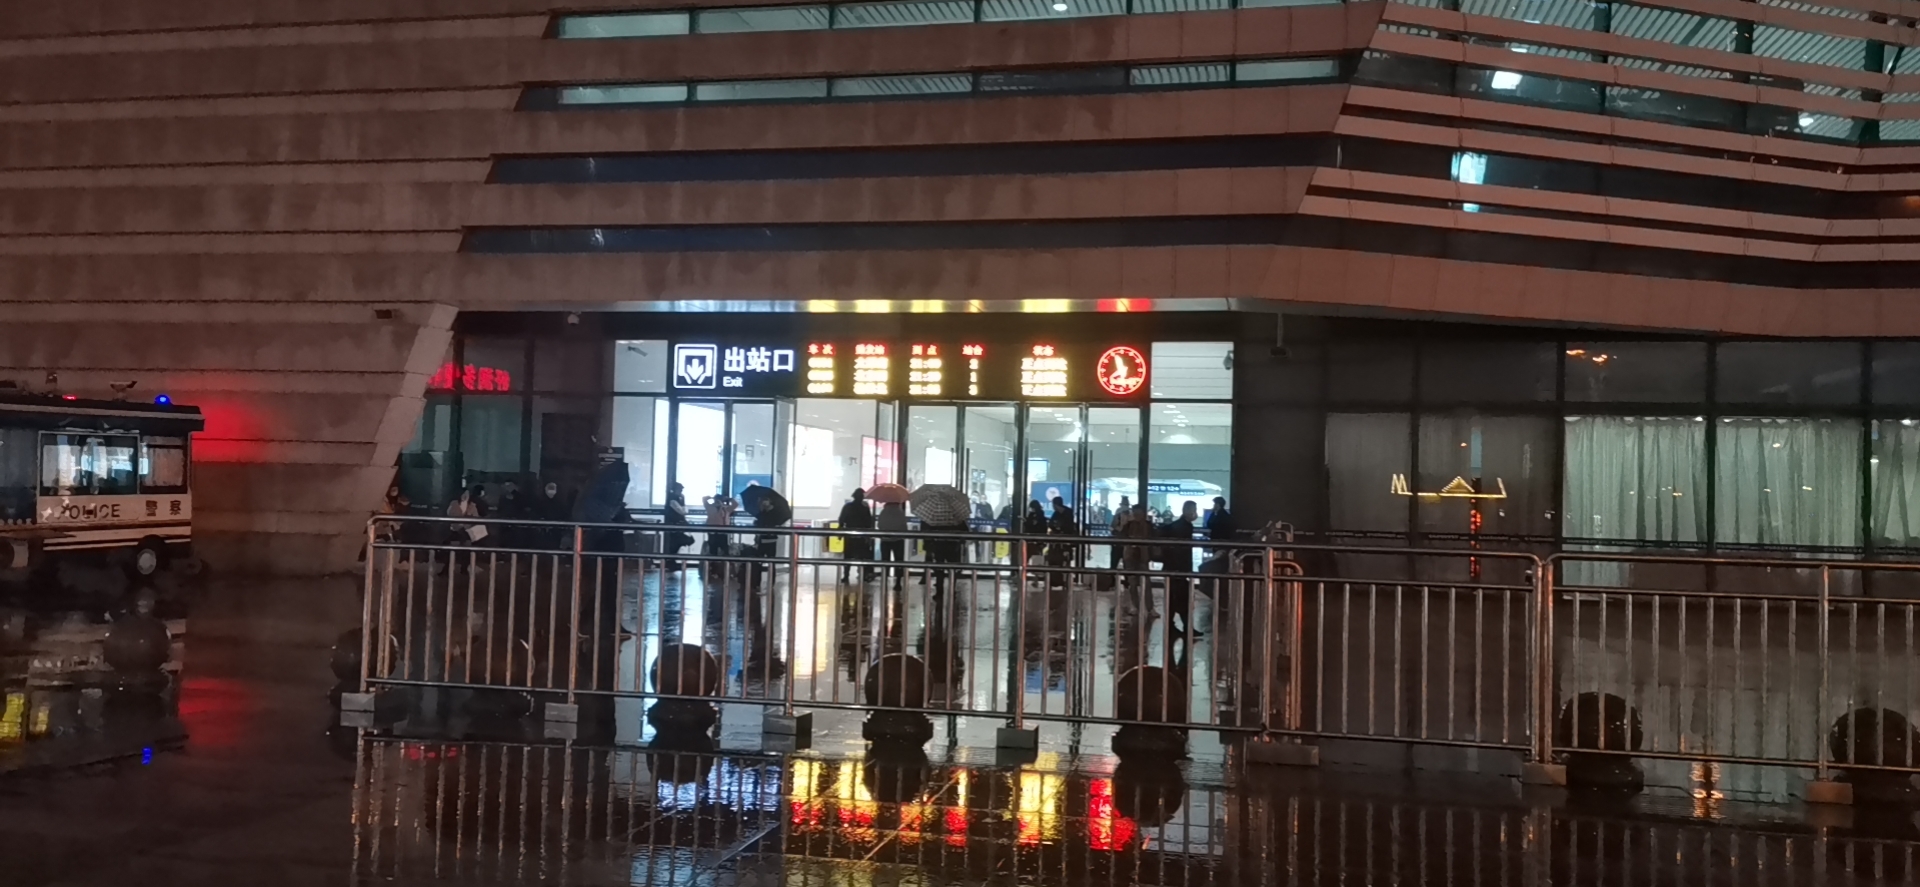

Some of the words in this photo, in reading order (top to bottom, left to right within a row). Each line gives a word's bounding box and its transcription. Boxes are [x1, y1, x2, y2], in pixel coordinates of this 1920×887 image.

[723, 346, 795, 373] 出站口
[722, 376, 744, 388] Exit
[145, 500, 181, 517] 警察
